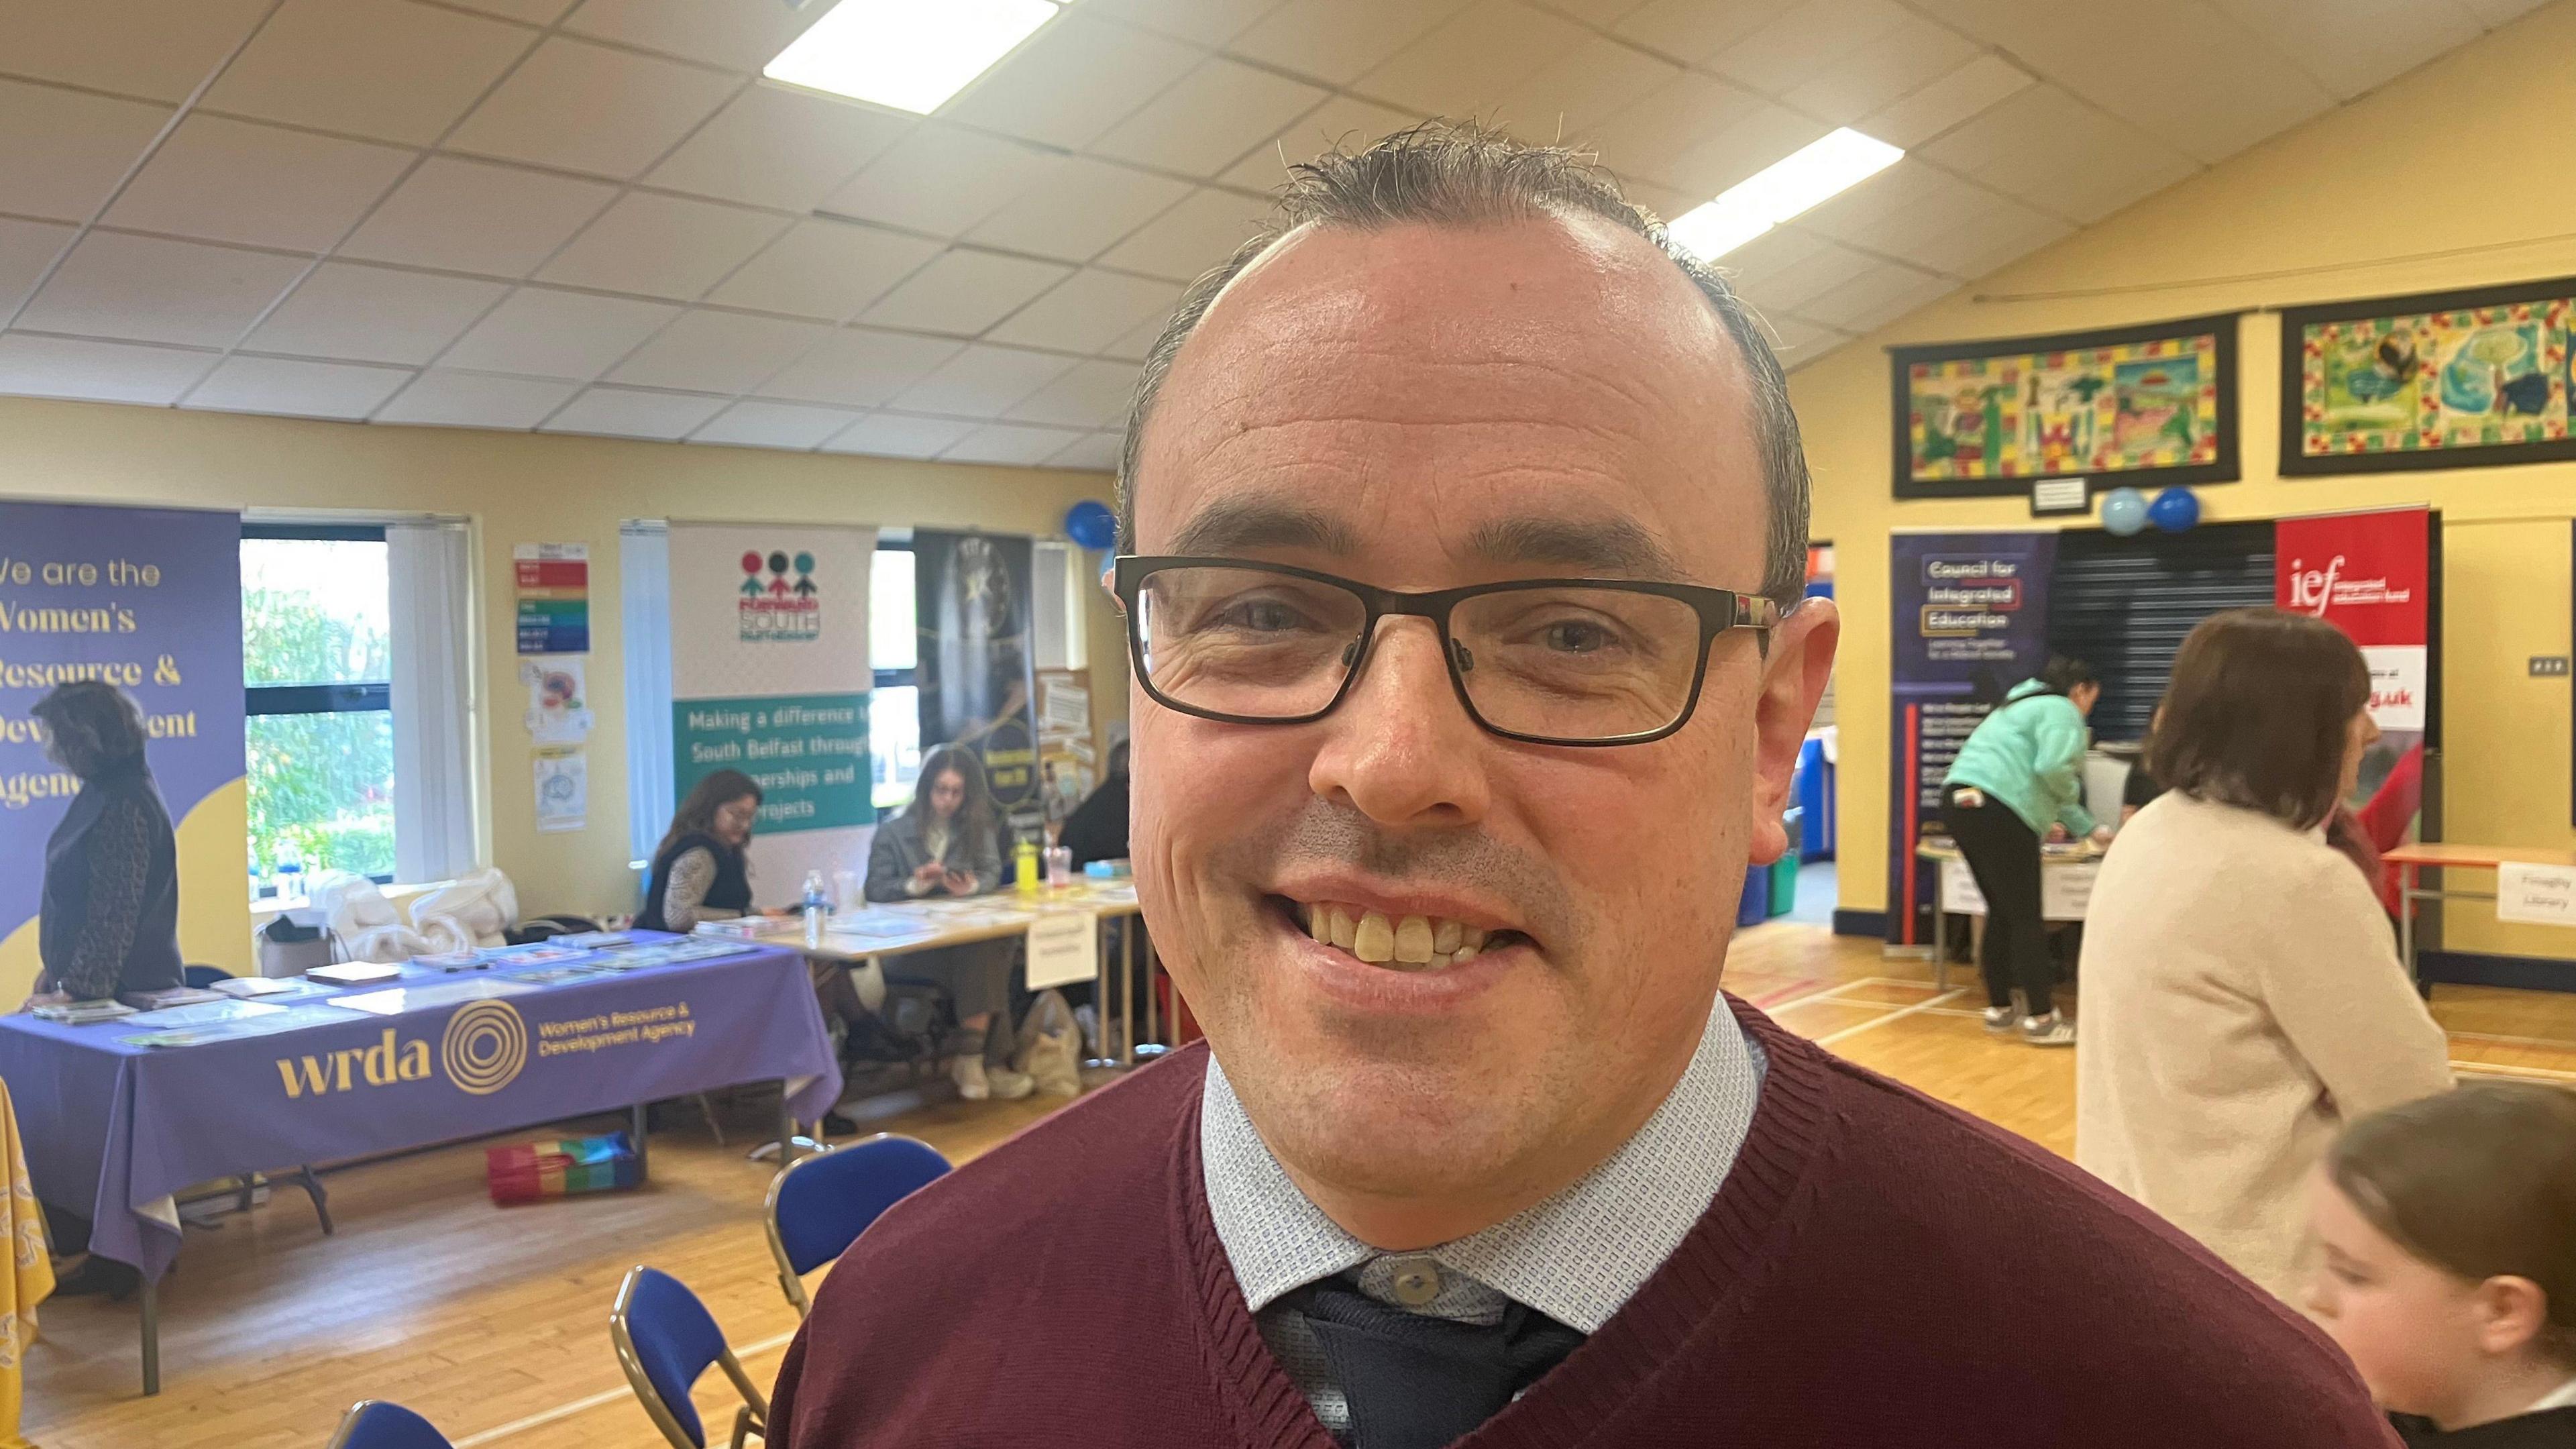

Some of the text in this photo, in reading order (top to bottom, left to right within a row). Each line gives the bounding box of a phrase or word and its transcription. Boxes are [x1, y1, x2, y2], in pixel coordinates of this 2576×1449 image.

[0, 557, 161, 587] e are the
[1929, 559, 2015, 578] Council for
[1929, 586, 2012, 606] Integrated
[2290, 554, 2345, 617] ief
[740, 611, 820, 630] SOUTH
[1929, 612, 2008, 629] Education
[0, 653, 181, 688] esource &
[689, 709, 751, 734] Making
[757, 711, 767, 727] a
[773, 705, 855, 727] difference
[692, 741, 741, 763] South
[748, 737, 804, 759] Belfast
[752, 765, 855, 790] nerships and
[755, 801, 816, 822] rojects
[538, 1001, 690, 1038] Women's Resource &
[538, 1020, 696, 1057] Development Agency
[276, 1027, 432, 1099] wrda
